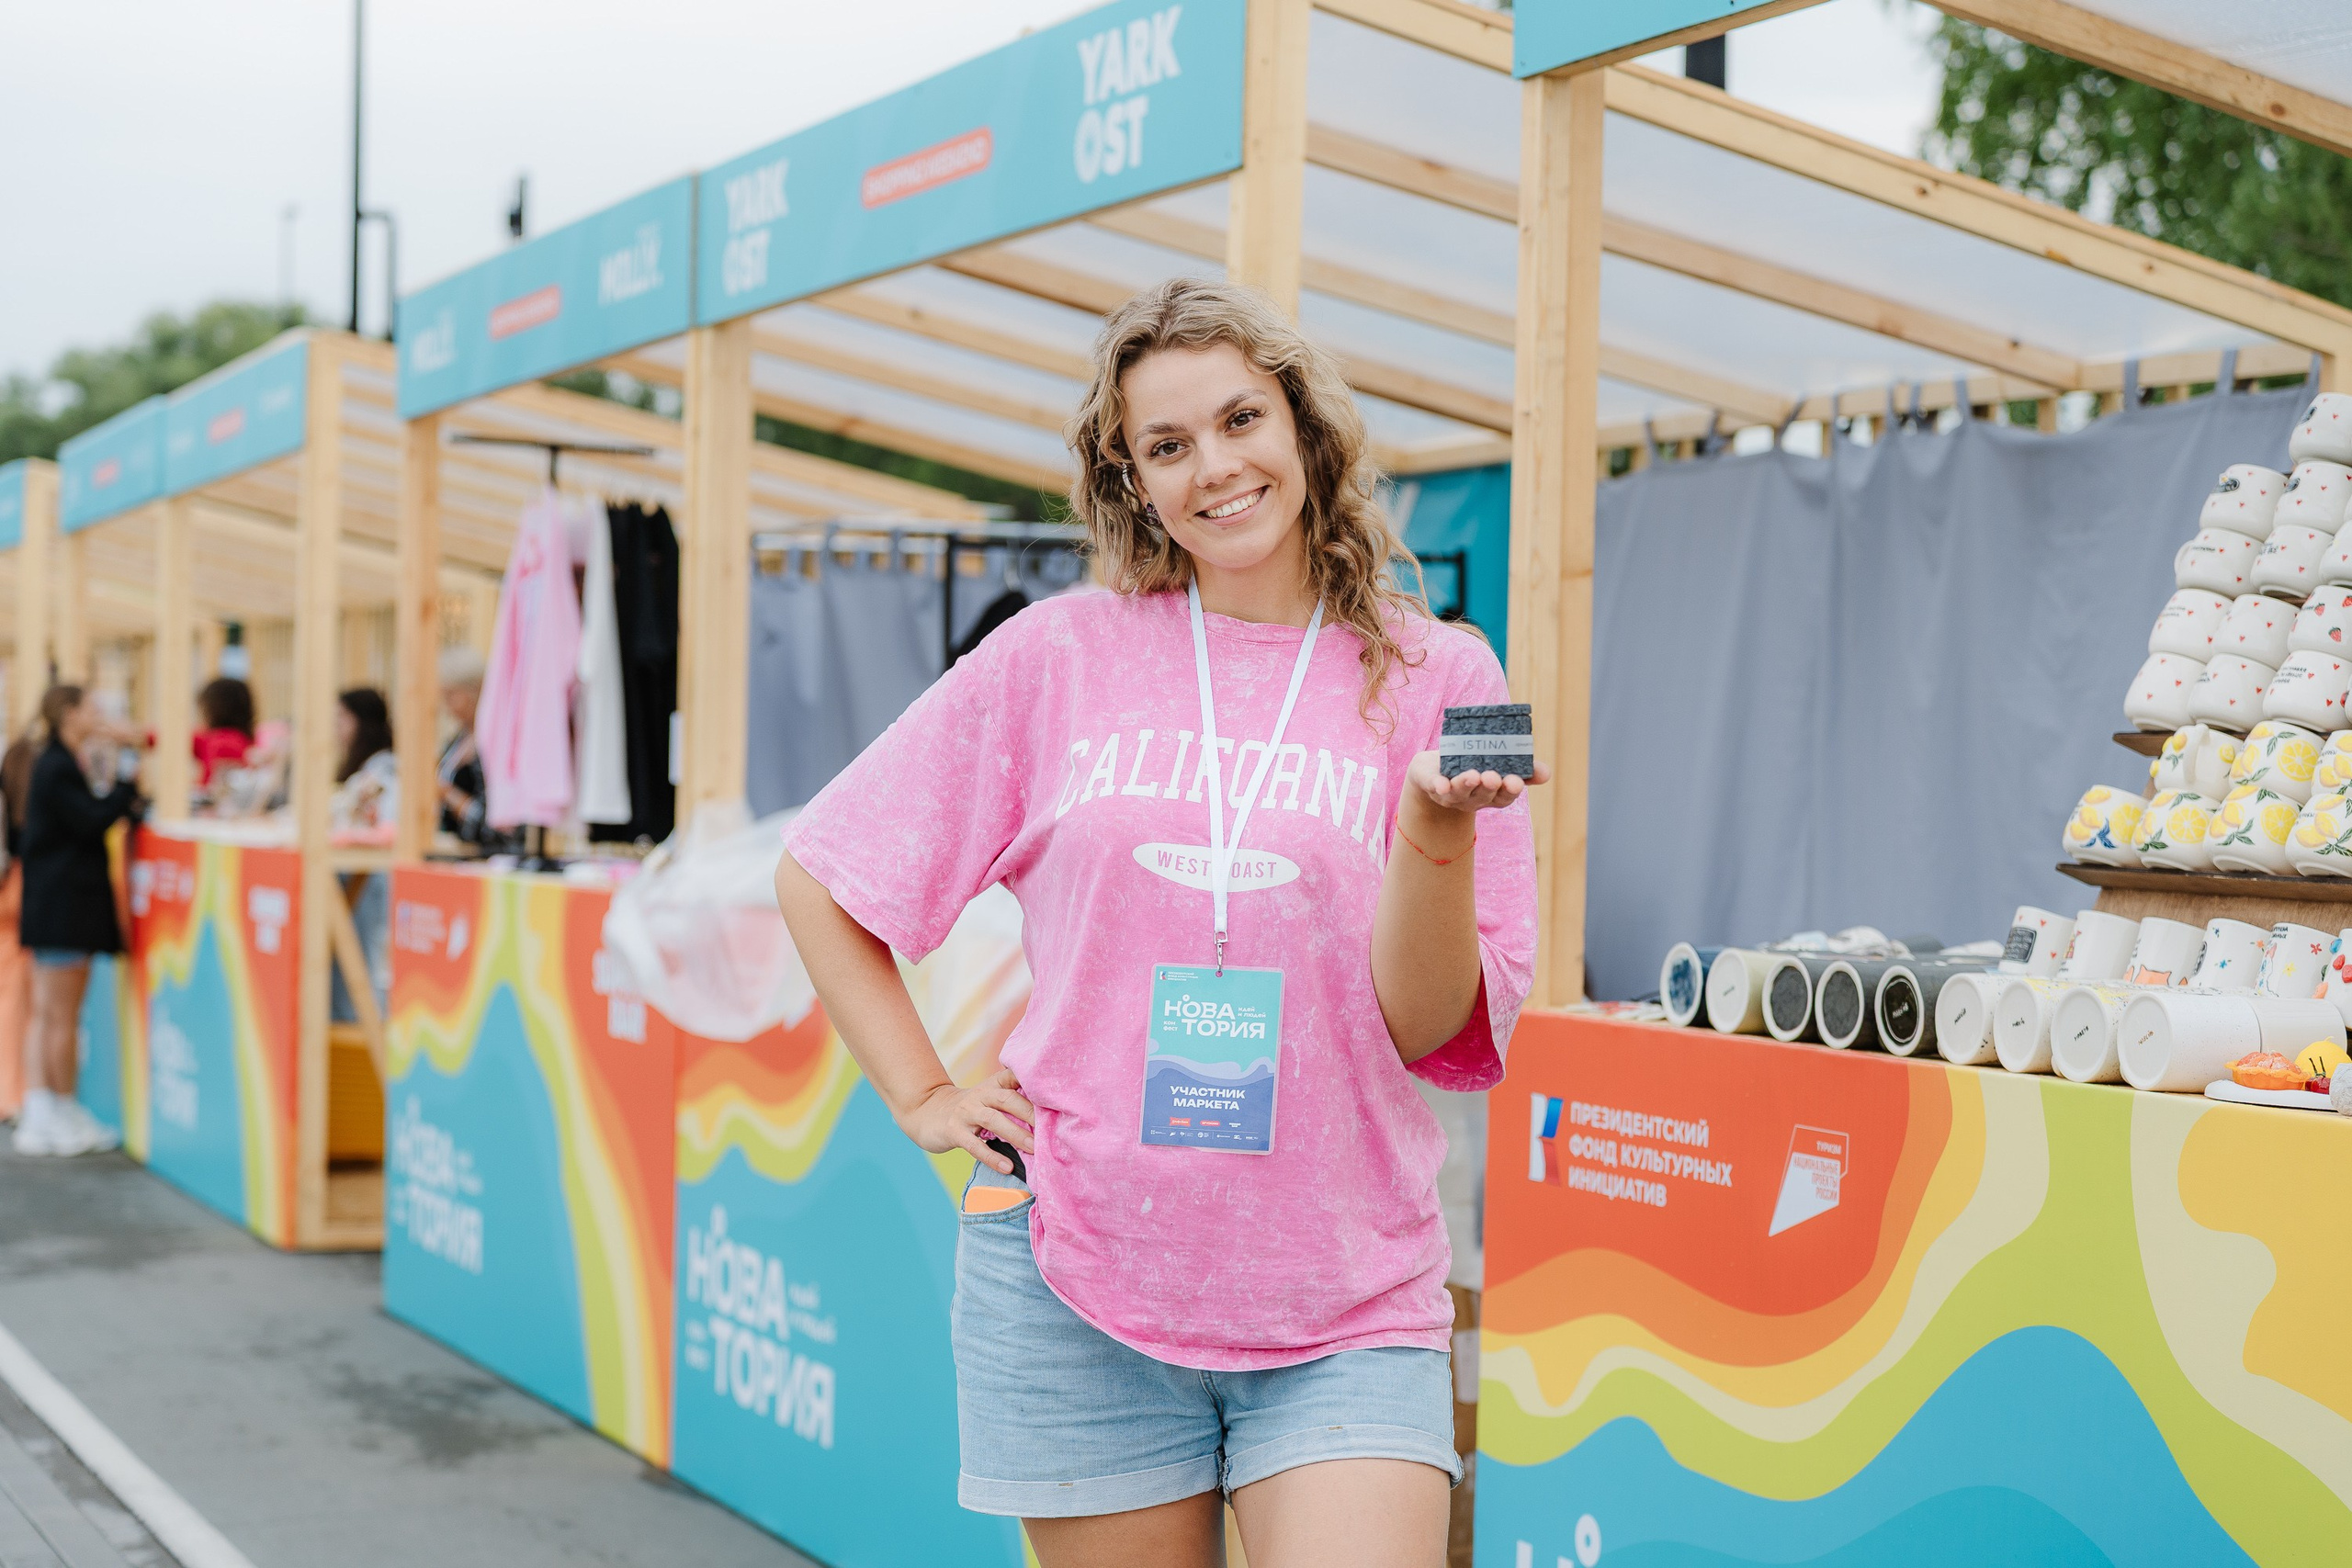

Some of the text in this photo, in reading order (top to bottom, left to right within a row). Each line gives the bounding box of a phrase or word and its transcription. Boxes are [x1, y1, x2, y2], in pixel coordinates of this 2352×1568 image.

[1077, 5, 1182, 106] YARK
[1073, 95, 1149, 184] OST
[1463, 739, 1507, 750] ISTINA
[1158, 850, 1212, 876] WEST
[1230, 862, 1277, 878] OAST
[1164, 994, 1236, 1020] НОВА
[1181, 1018, 1266, 1039] ТОРИЯ
[1170, 1086, 1246, 1100] УЧАСТНИК
[1173, 1097, 1240, 1111] МАРКЕТА
[1570, 1100, 1709, 1148] ПРЕЗИДЕНТСКИЙ
[1568, 1134, 1733, 1187] ФОНД КУЛЬТУРНЫХ
[1568, 1165, 1668, 1207] ИНИЦИАТИВ
[708, 1314, 836, 1449] ТОРИЯ
